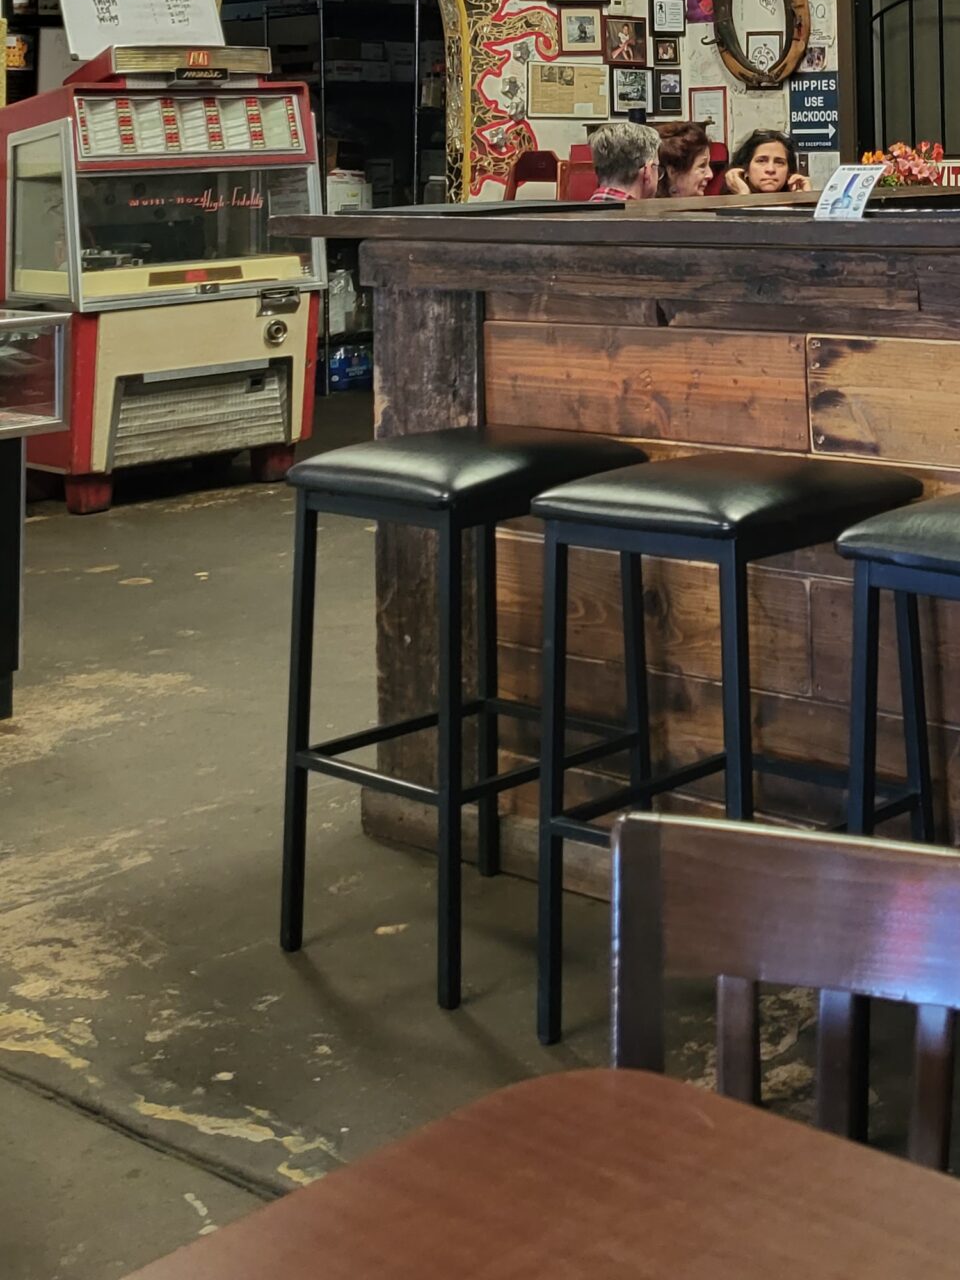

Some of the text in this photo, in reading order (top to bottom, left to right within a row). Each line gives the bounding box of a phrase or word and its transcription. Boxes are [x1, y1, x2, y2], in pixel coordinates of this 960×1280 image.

[791, 79, 836, 92] HIPPIES
[804, 96, 824, 107] USE
[791, 110, 838, 122] BACKDOOR
